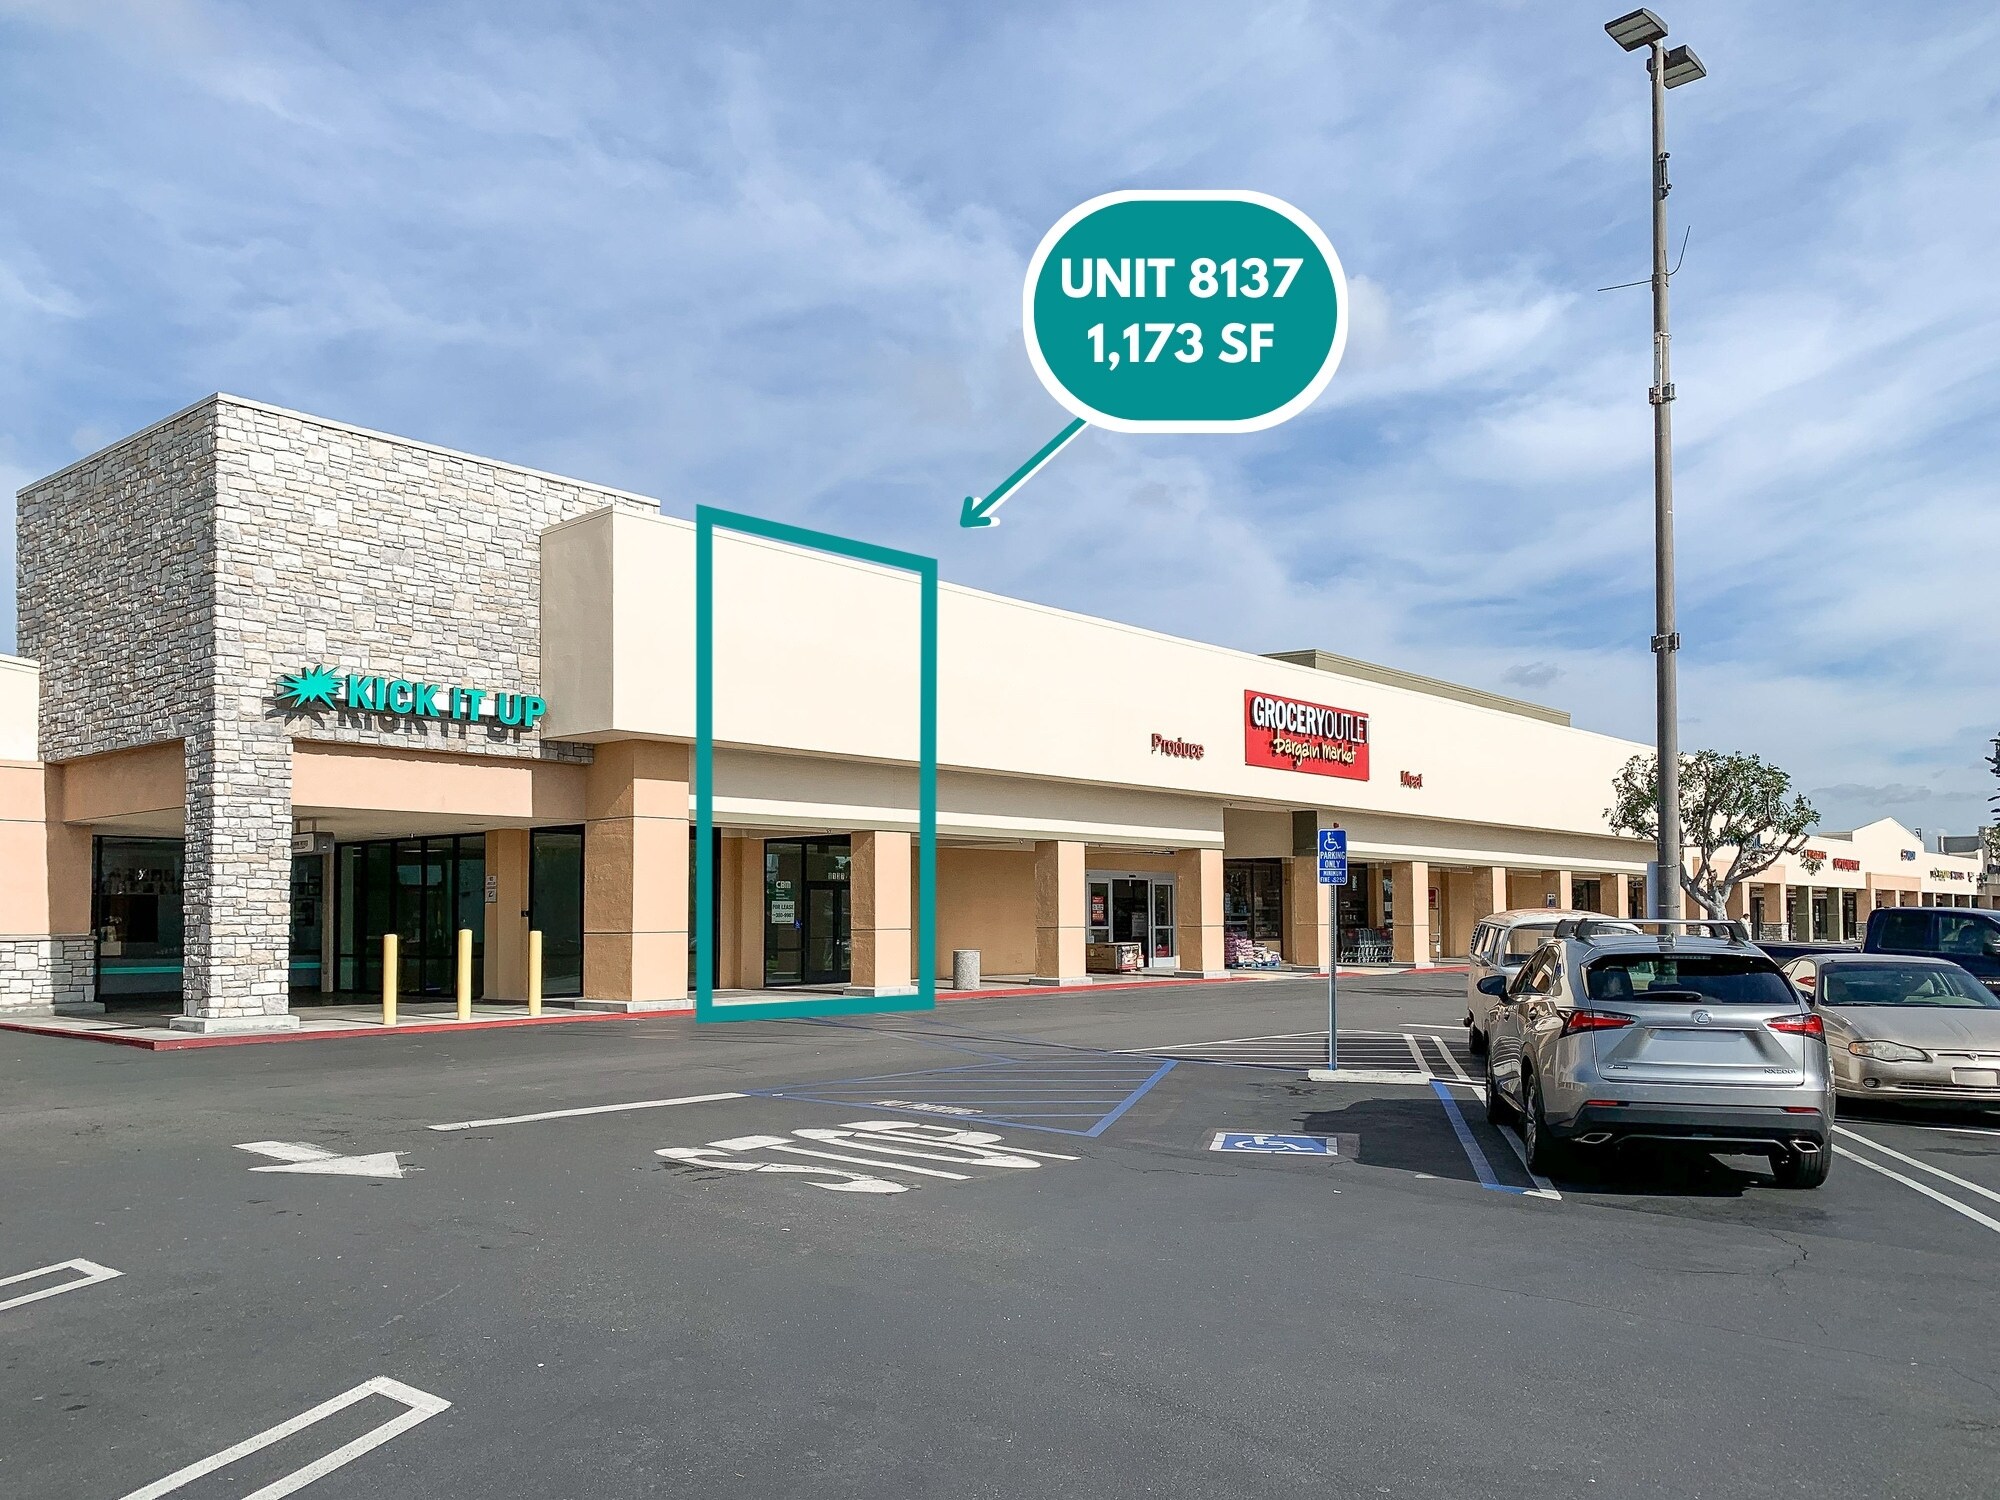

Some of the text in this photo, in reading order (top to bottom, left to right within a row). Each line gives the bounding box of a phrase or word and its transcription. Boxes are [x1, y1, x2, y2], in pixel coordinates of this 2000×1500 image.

[346, 674, 547, 727] KICK IT UP
[1151, 733, 1204, 760] Produce
[1400, 770, 1424, 789] Meat
[1320, 851, 1346, 860] PARKING
[1324, 860, 1341, 868] ONLY
[652, 1120, 1082, 1193] STOP
